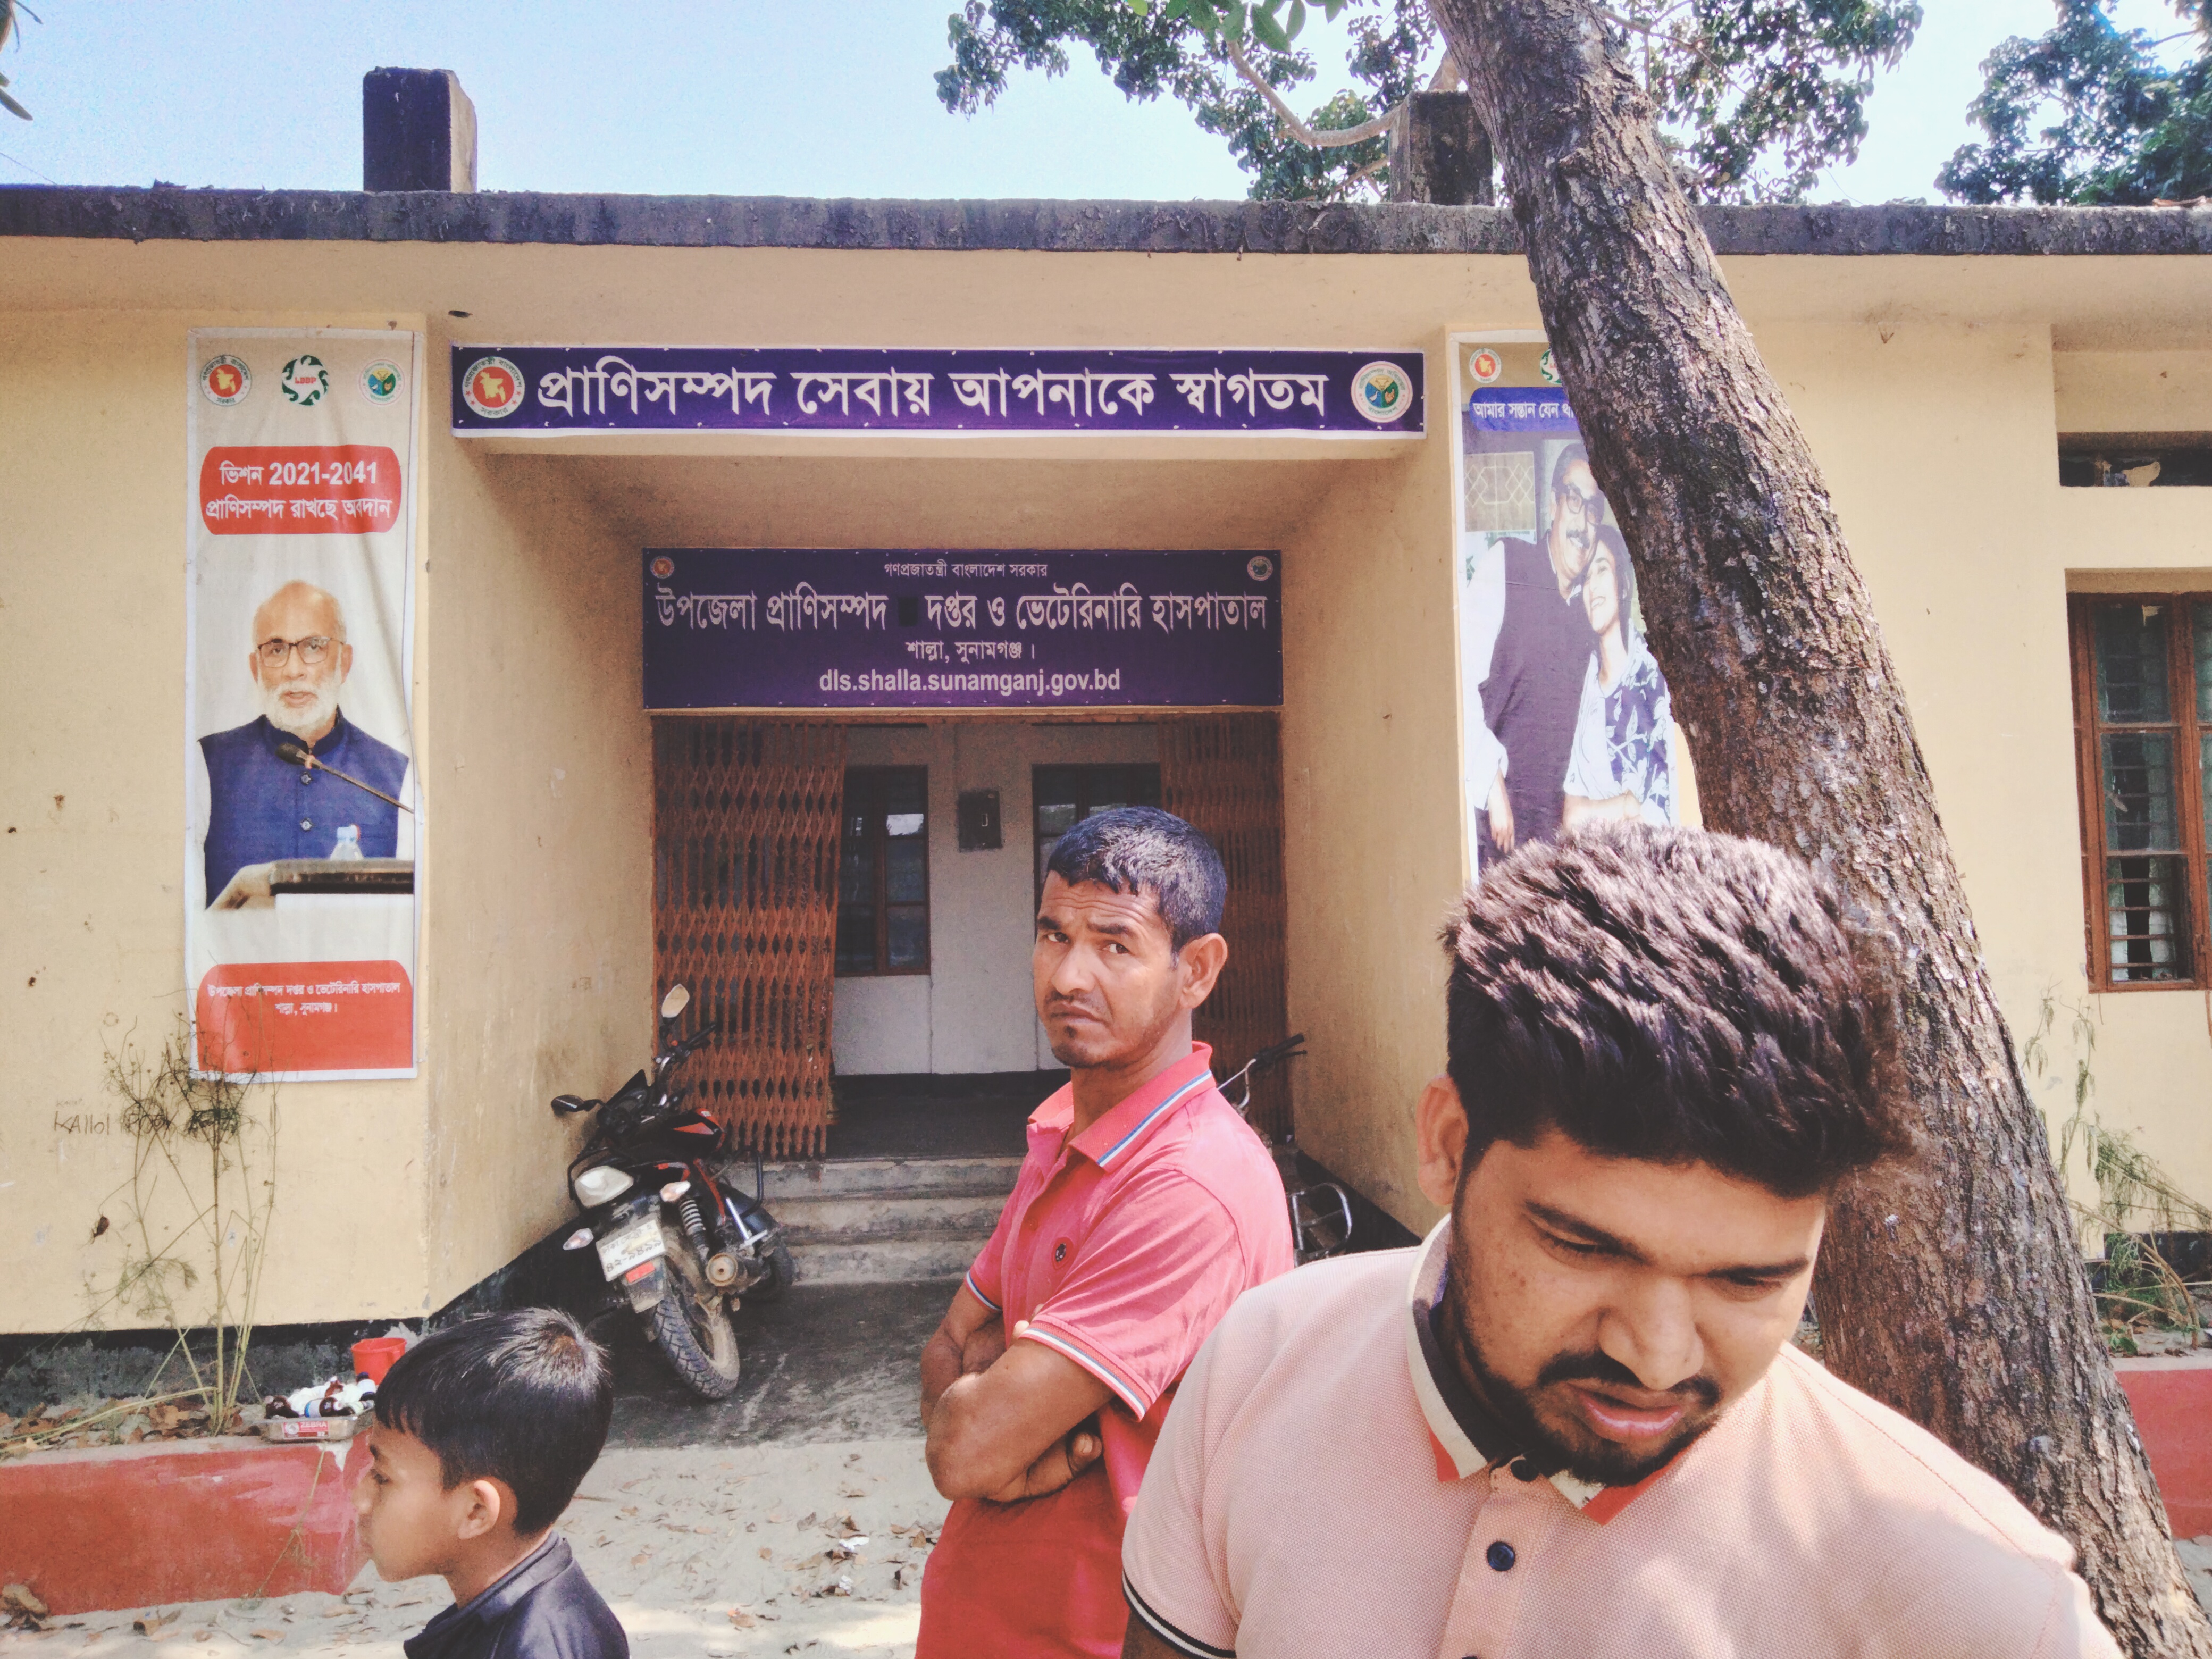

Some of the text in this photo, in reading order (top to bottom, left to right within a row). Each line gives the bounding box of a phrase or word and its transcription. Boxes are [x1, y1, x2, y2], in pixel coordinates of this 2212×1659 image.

[538, 356, 1329, 417] প্রাণিসম্পদ সেবায় আপনাকে স্বাগতম
[481, 407, 508, 415] সরকার
[1473, 402, 1574, 418] আমার সন্তান যেন থা
[219, 460, 377, 485] ভিশন 2021-2041
[206, 494, 392, 521] প্রাণিসম্পদ রাখছে অবদান
[884, 559, 1048, 577] গণপ্রজাতন্ত্রী বাংলাদেশ সরকার
[656, 582, 1267, 633] উপজেলা প্রাণিসম্পদ দপ্তর ও ভেটেরিনারি হাসপাতাল
[906, 641, 949, 663] শাল্লা,
[954, 640, 1022, 664] সুনামগঞ্জ
[820, 669, 1119, 696] dls.shalla.sunamganj.gov.bd
[307, 985, 314, 994] ও
